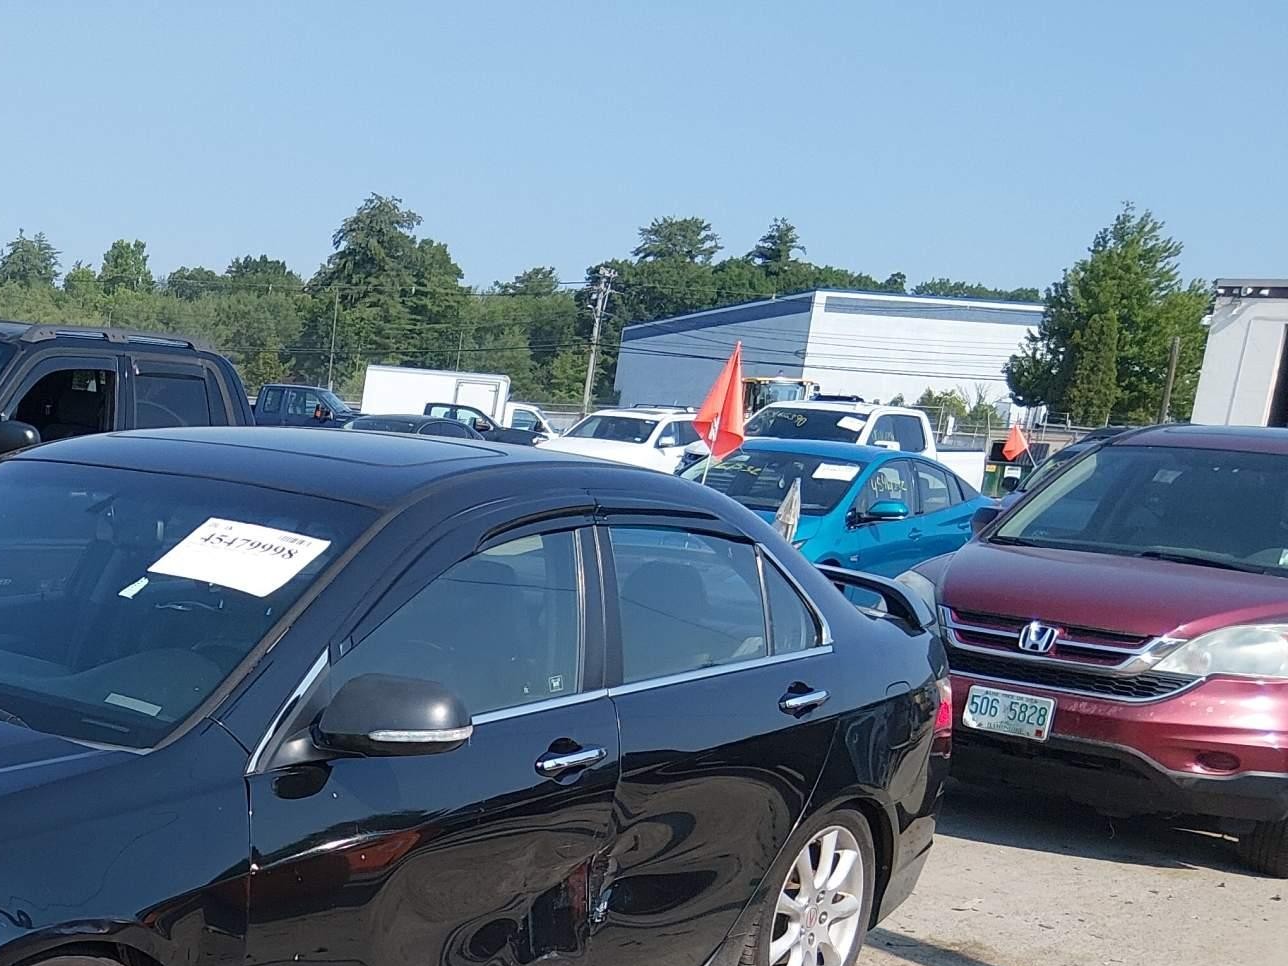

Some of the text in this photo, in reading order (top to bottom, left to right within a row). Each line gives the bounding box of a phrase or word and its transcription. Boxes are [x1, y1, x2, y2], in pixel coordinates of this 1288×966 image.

[200, 532, 299, 560] 45479998
[968, 694, 1000, 718] 506
[1007, 701, 1048, 727] 5828
